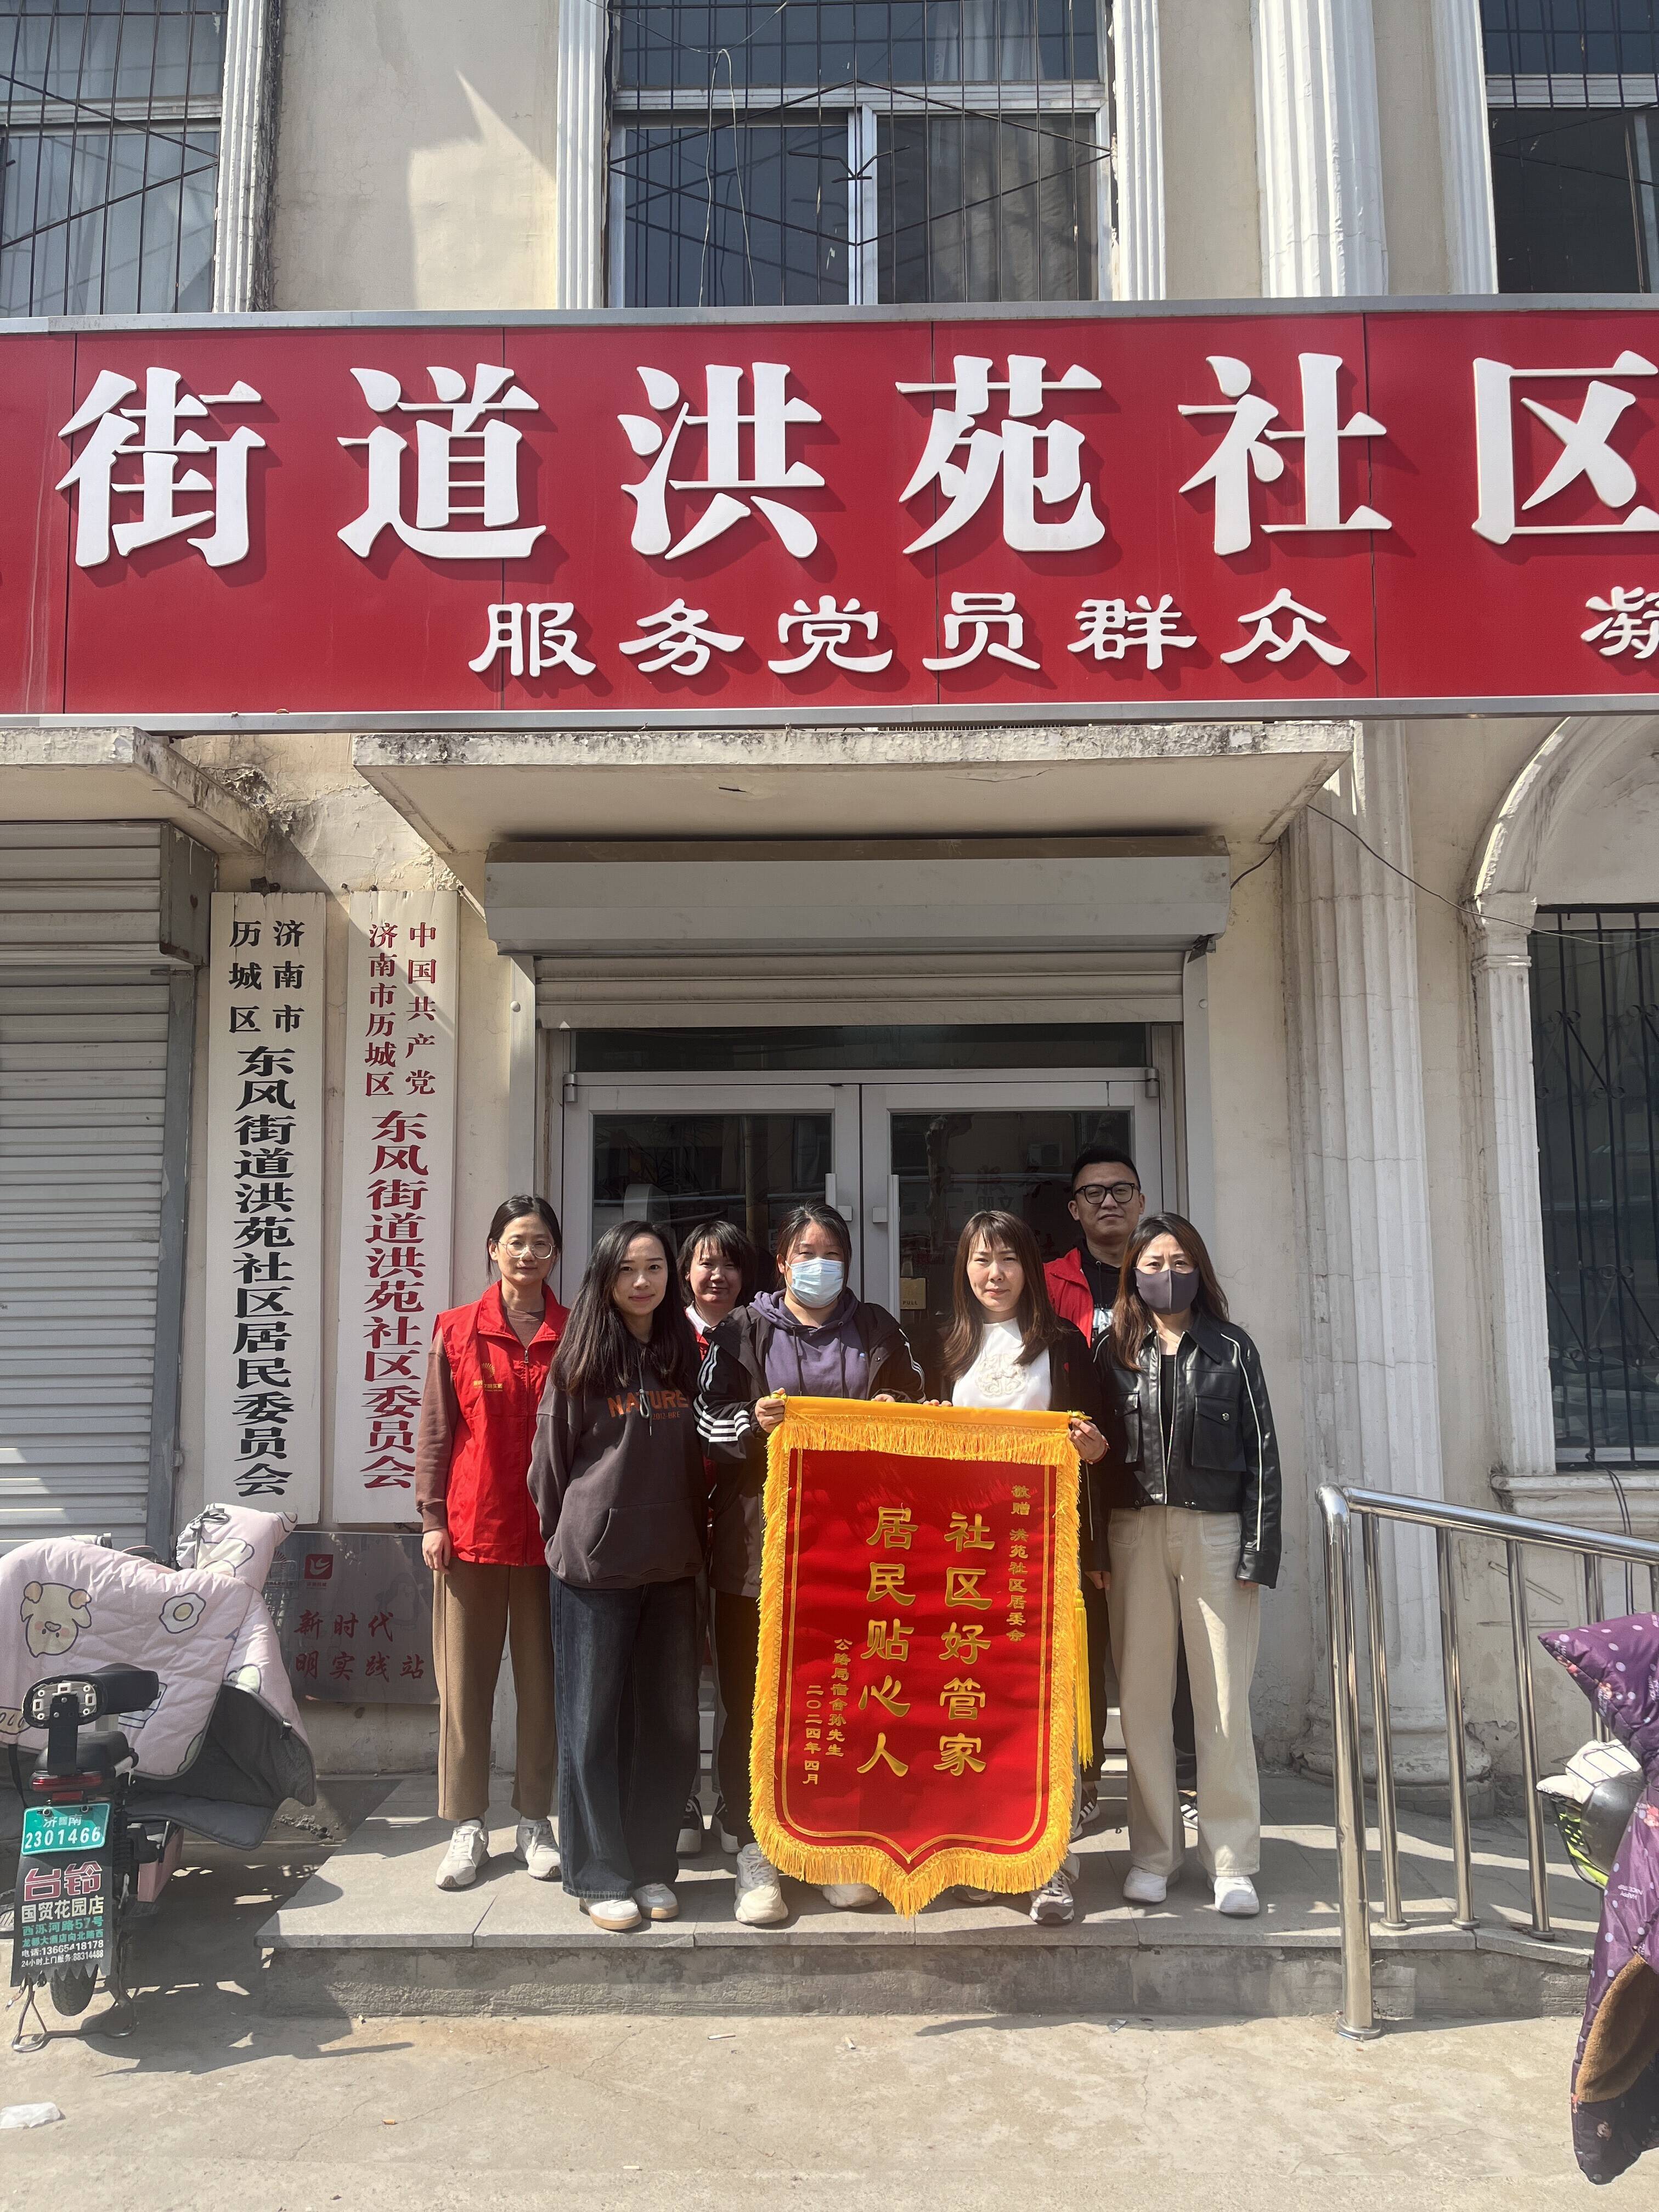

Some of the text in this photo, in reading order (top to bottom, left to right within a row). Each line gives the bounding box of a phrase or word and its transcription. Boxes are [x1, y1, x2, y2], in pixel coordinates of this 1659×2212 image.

[55, 349, 1659, 567] 街道洪苑社区
[468, 588, 1351, 676] 服务党员群众
[228, 919, 262, 1034] 历城区
[272, 919, 305, 1033] 济南市
[364, 922, 398, 1097] 济南市历城区
[405, 922, 436, 1096] 中国共产党
[232, 1046, 296, 1497] 东风街道洪苑社区居民委员会
[360, 1110, 429, 1489] 东风街道洪苑社区委员会
[294, 1610, 394, 1642] 新时代
[1006, 1485, 1031, 1643] 敬赠 洪苑社区居委会
[825, 1638, 853, 1757] 公路局宿舍孙先生
[856, 1506, 918, 1778] 居民贴心人
[933, 1512, 995, 1777] 社区好管家
[24, 1860, 103, 1902] 台铃
[25, 1826, 101, 1849] 2301466
[21, 1894, 105, 1923] 国贸花园店
